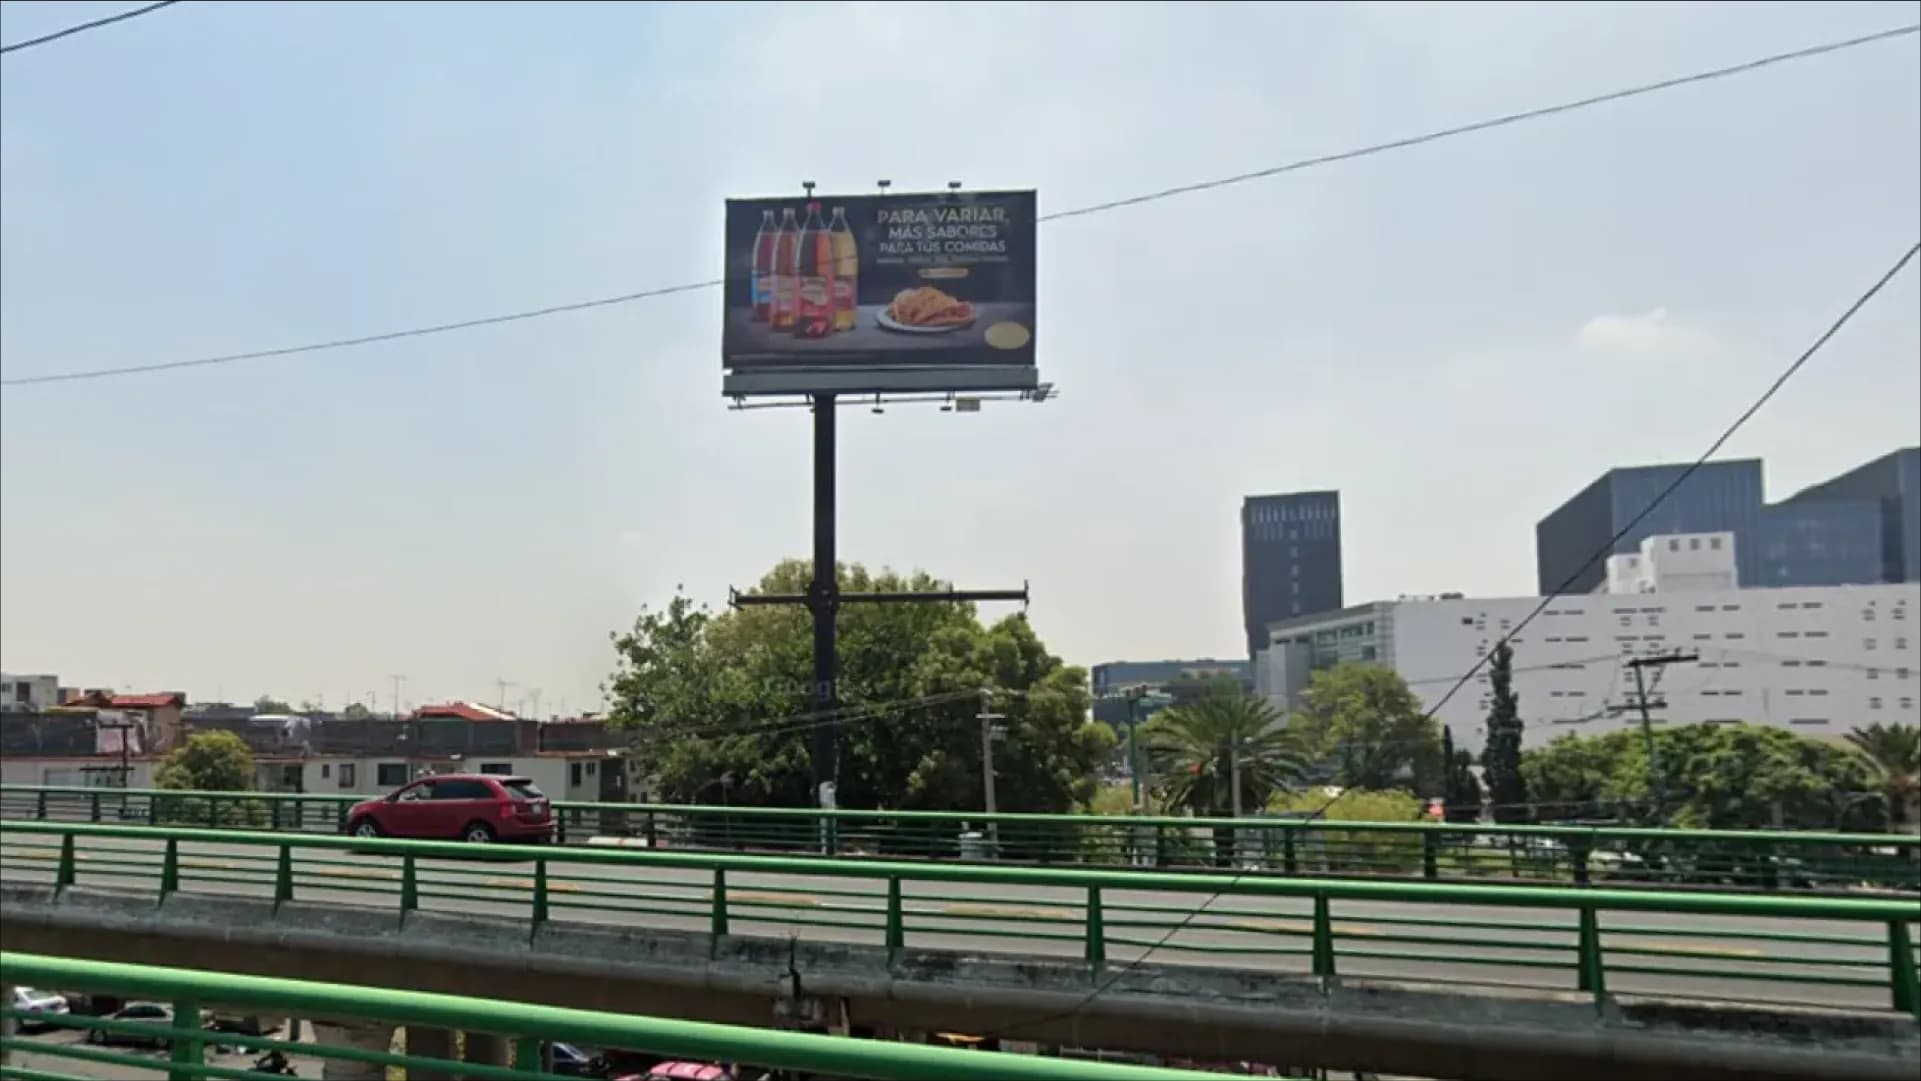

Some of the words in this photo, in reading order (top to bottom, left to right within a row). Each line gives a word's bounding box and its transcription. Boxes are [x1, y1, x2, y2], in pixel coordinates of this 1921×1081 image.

[877, 209, 928, 224] PARA
[934, 207, 1010, 226] VARIAR,
[927, 224, 997, 239] SABORES
[880, 241, 914, 254] PARA
[945, 240, 1006, 253] COMIDAS
